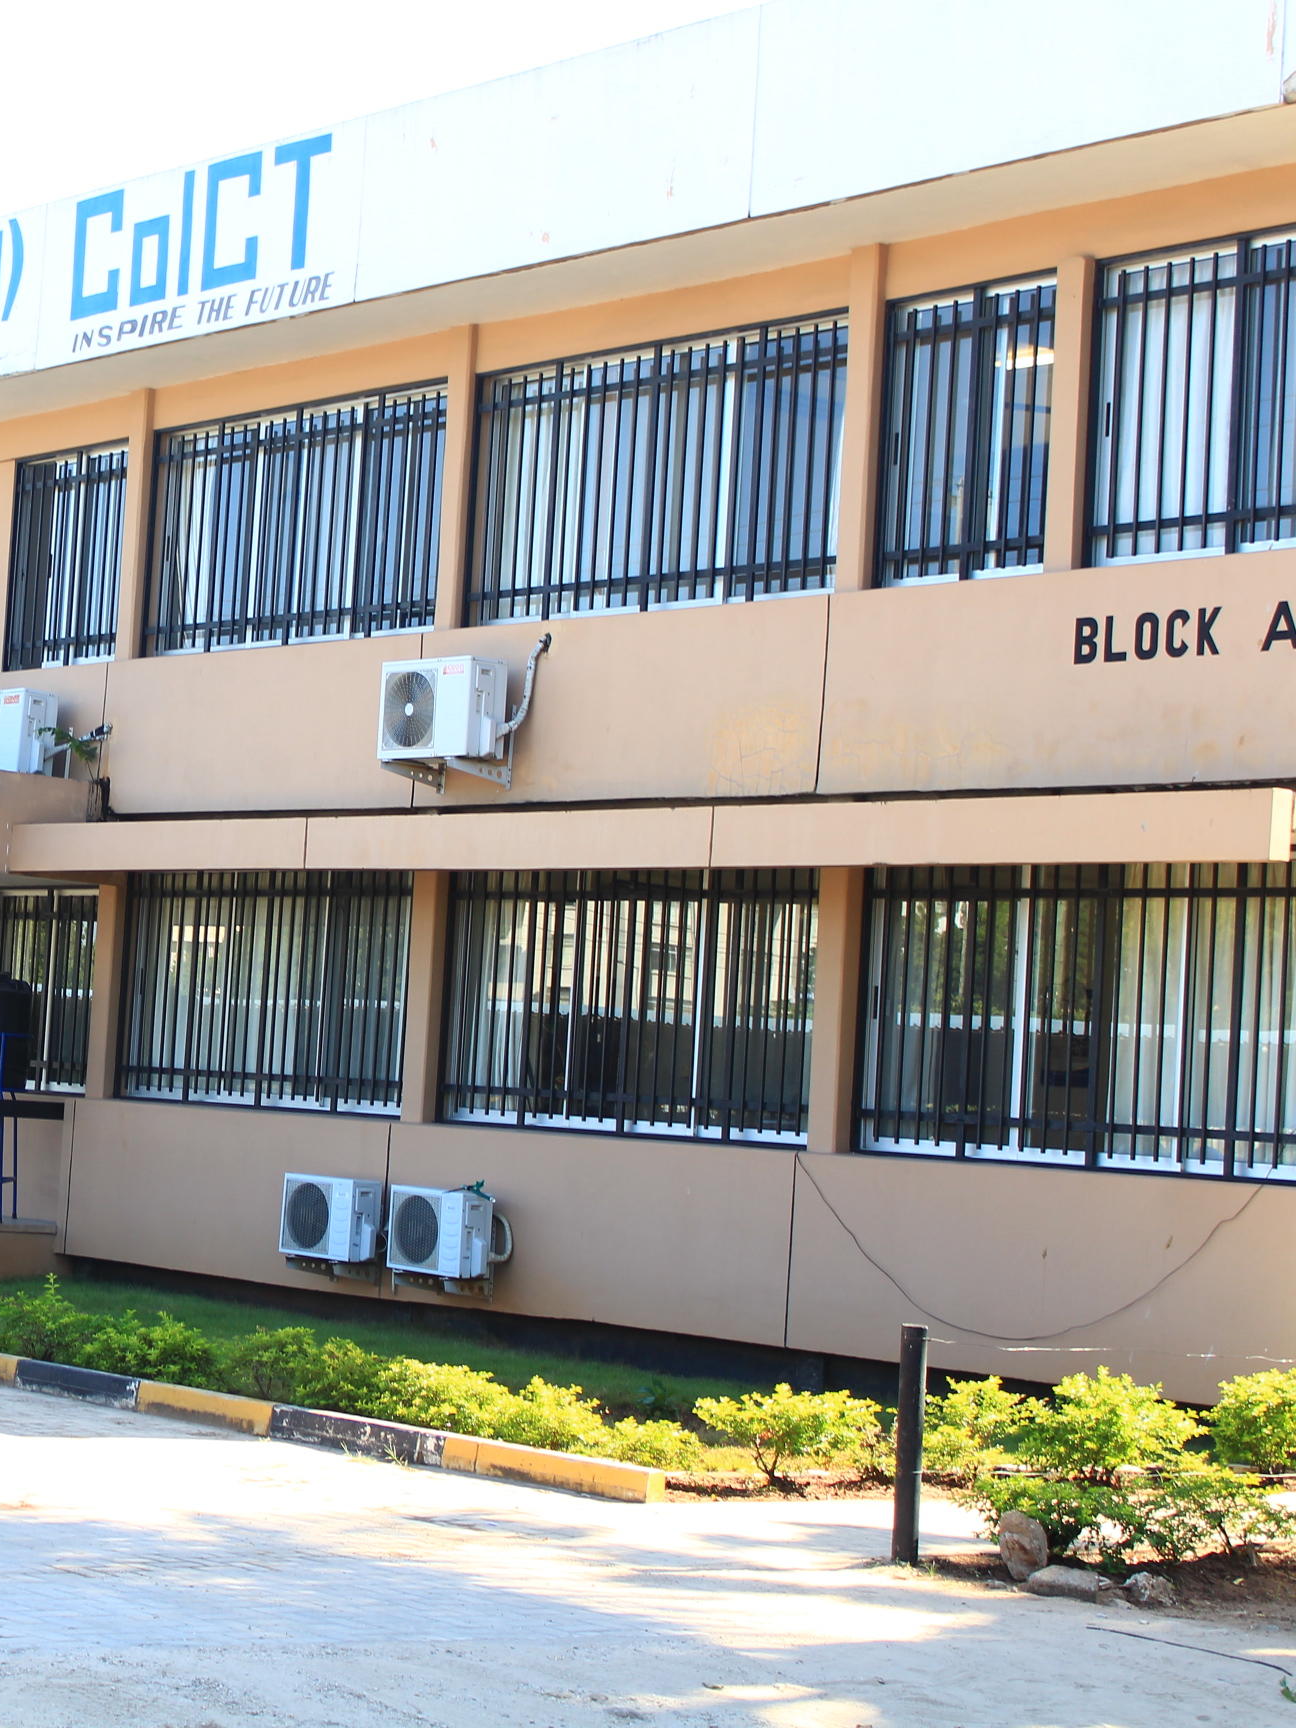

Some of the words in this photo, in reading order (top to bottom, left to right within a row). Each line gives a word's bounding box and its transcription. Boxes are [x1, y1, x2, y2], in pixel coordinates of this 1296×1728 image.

[70, 132, 333, 321] CoICT
[72, 305, 187, 354] INSPIRE
[197, 293, 238, 326] THE
[245, 271, 335, 318] FUTURE
[1073, 606, 1223, 665] BLOCK
[1260, 600, 1296, 652] A
